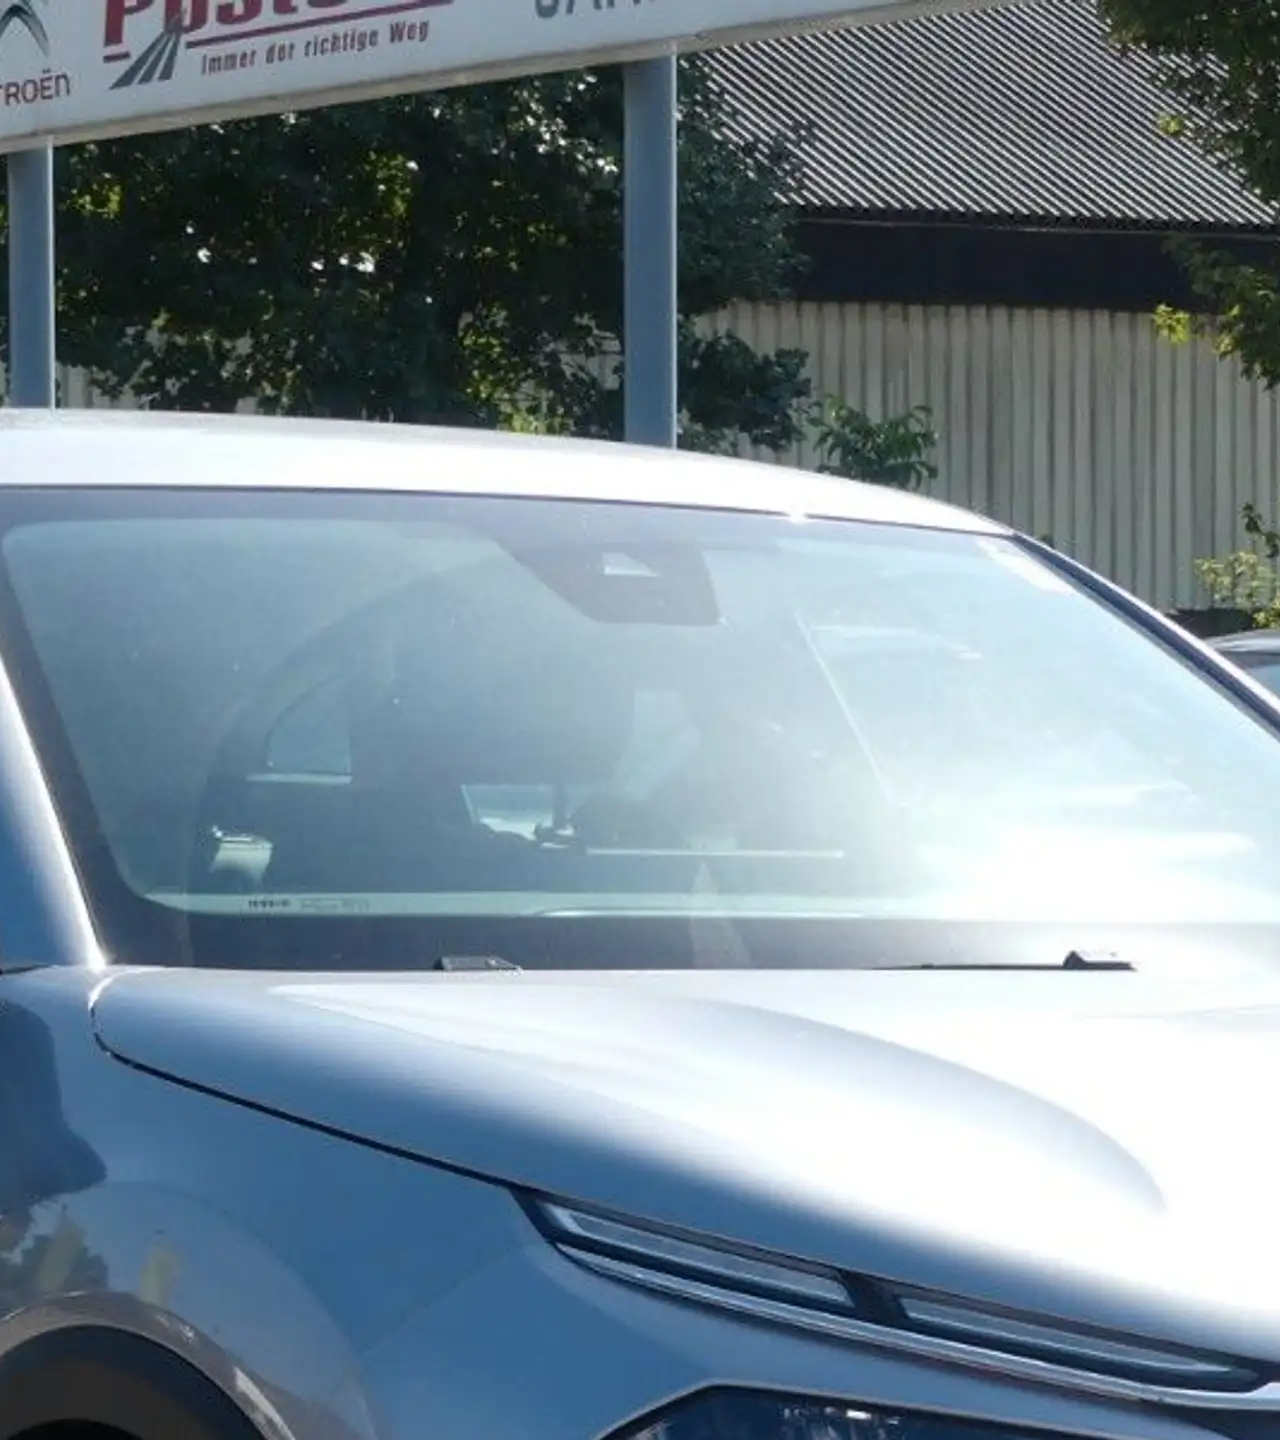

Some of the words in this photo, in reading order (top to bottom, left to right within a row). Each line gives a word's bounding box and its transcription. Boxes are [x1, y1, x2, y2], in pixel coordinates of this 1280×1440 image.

[201, 51, 255, 76] Immer
[266, 41, 296, 64] der
[304, 29, 378, 57] richtige
[389, 20, 429, 44] Weg
